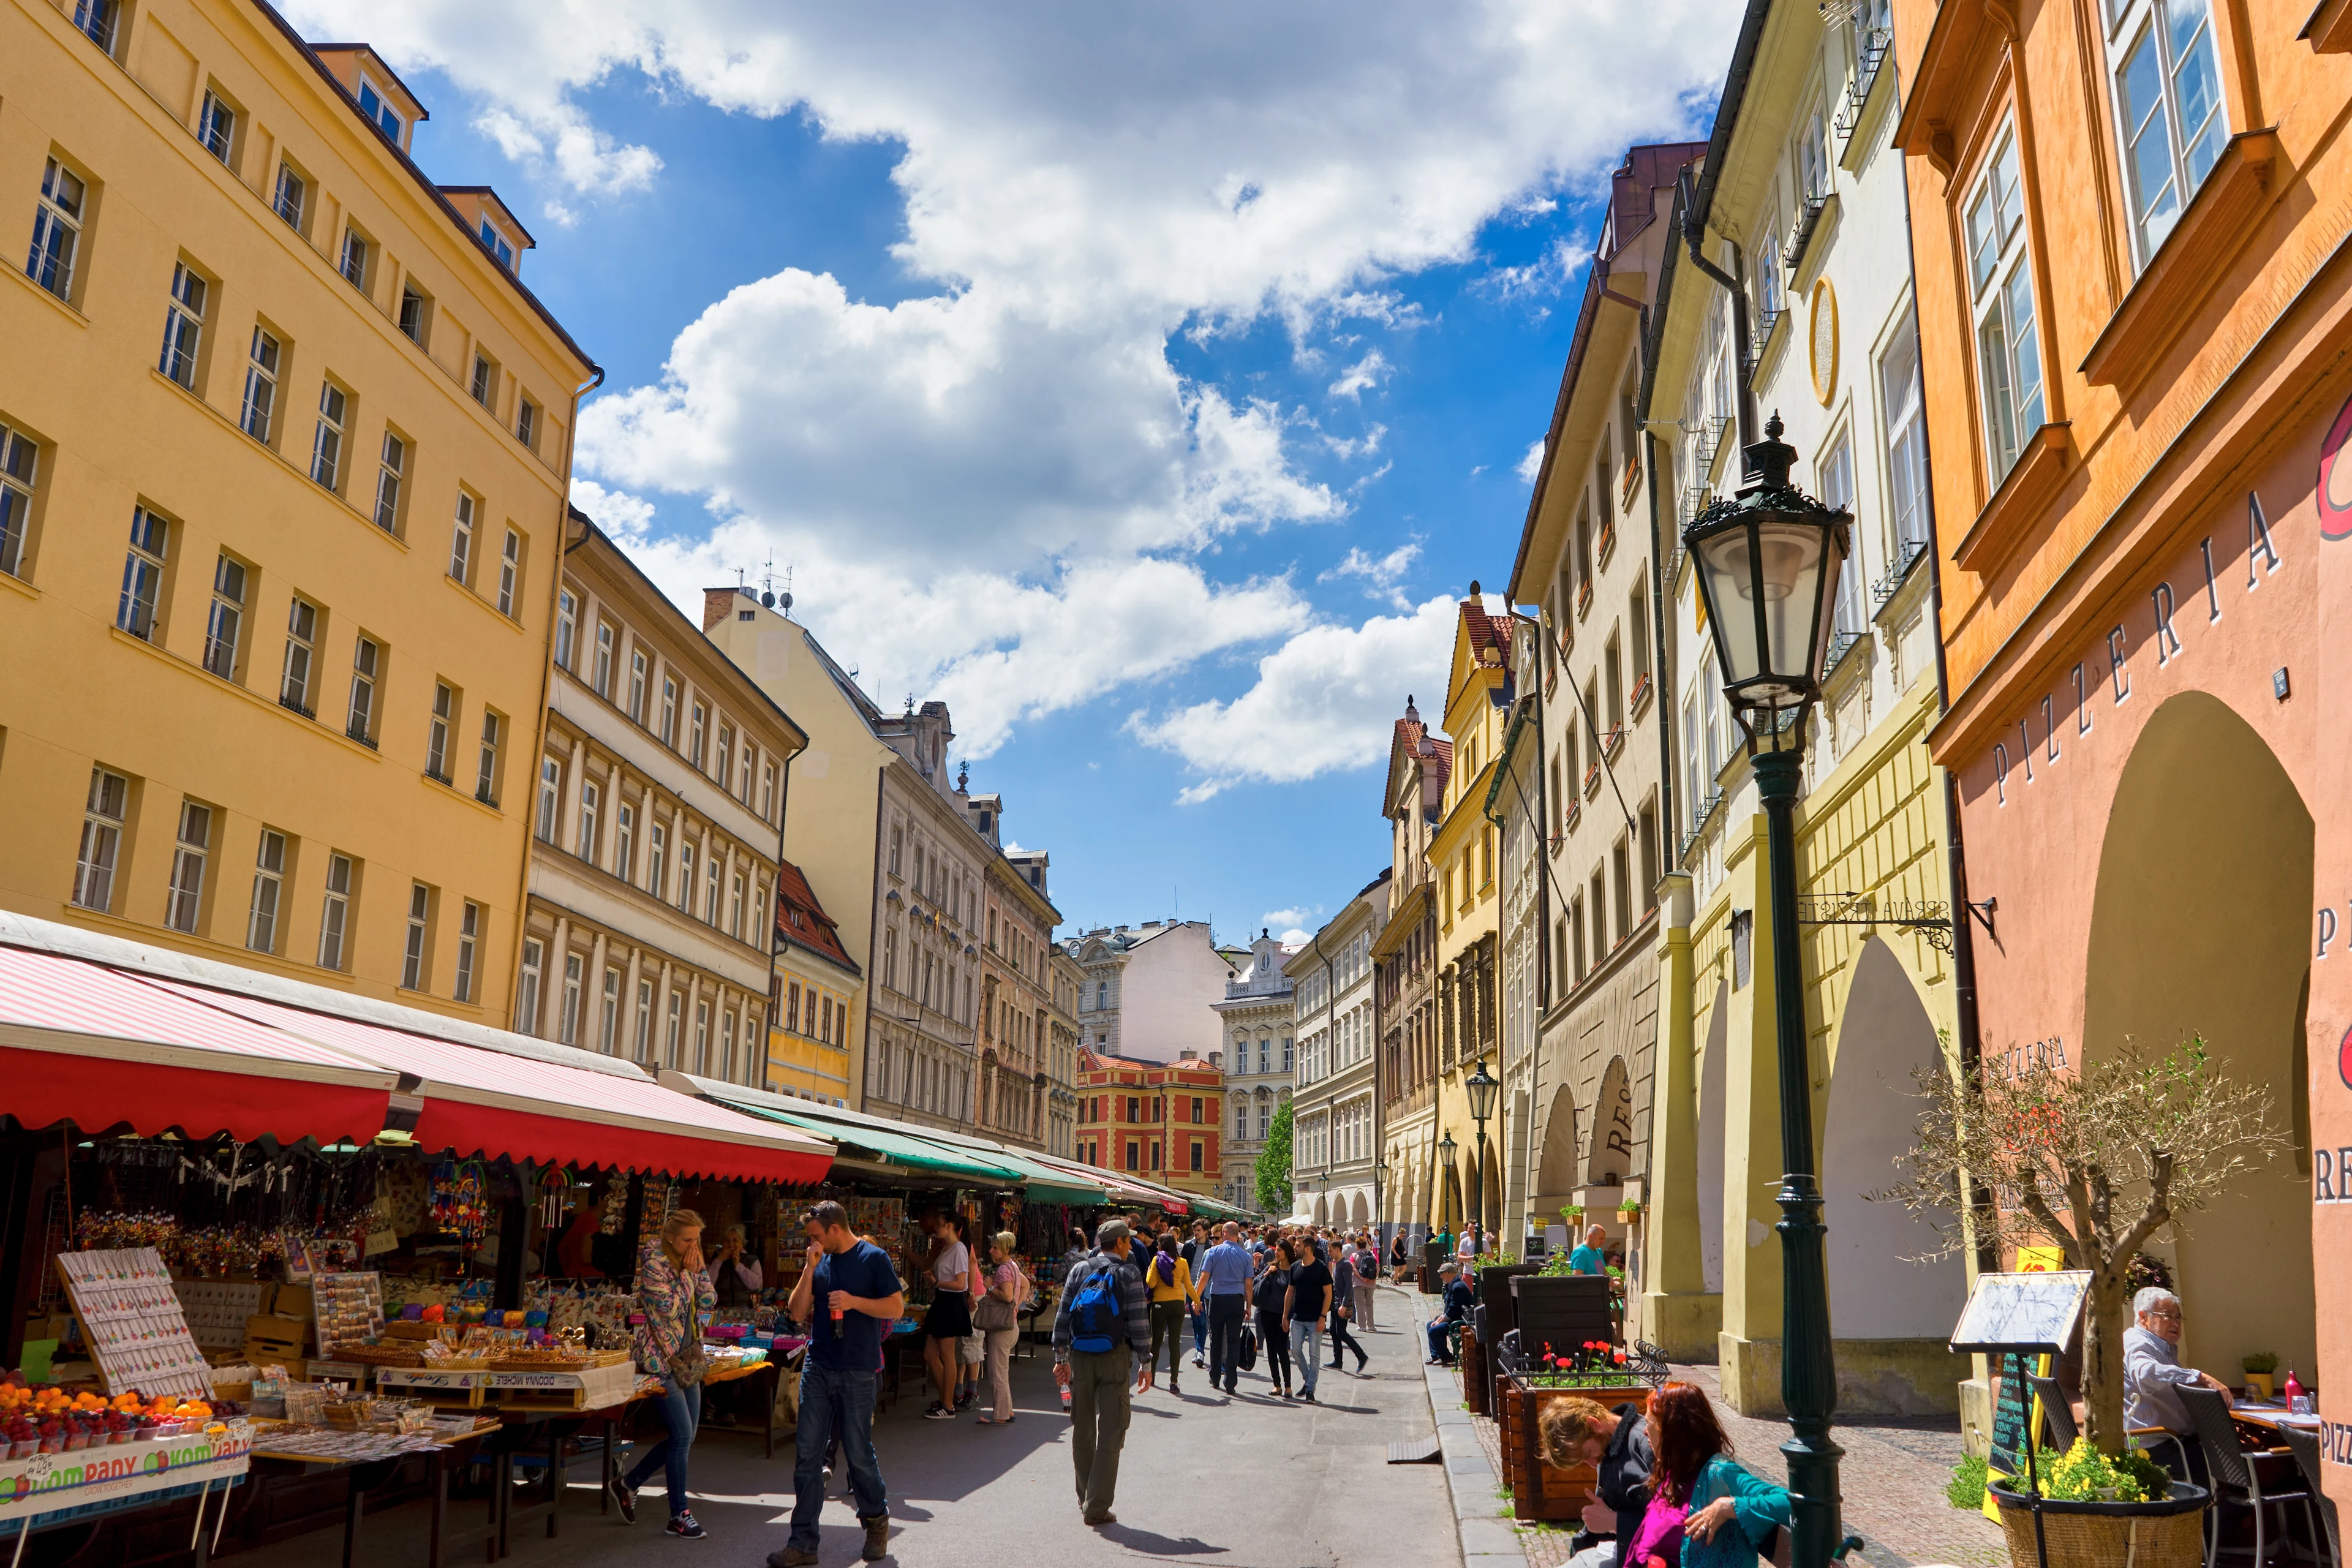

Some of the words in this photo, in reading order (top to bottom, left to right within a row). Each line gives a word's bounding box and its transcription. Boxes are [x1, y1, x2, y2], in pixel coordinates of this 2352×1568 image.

[1994, 491, 2282, 808] PIZZERIA
[1987, 1036, 2068, 1084] ZZERIA
[496, 1376, 524, 1385] MICHELE
[526, 1376, 555, 1385] DIDONNA
[84, 1485, 103, 1496] GROW
[104, 1479, 134, 1492] TOGETHER
